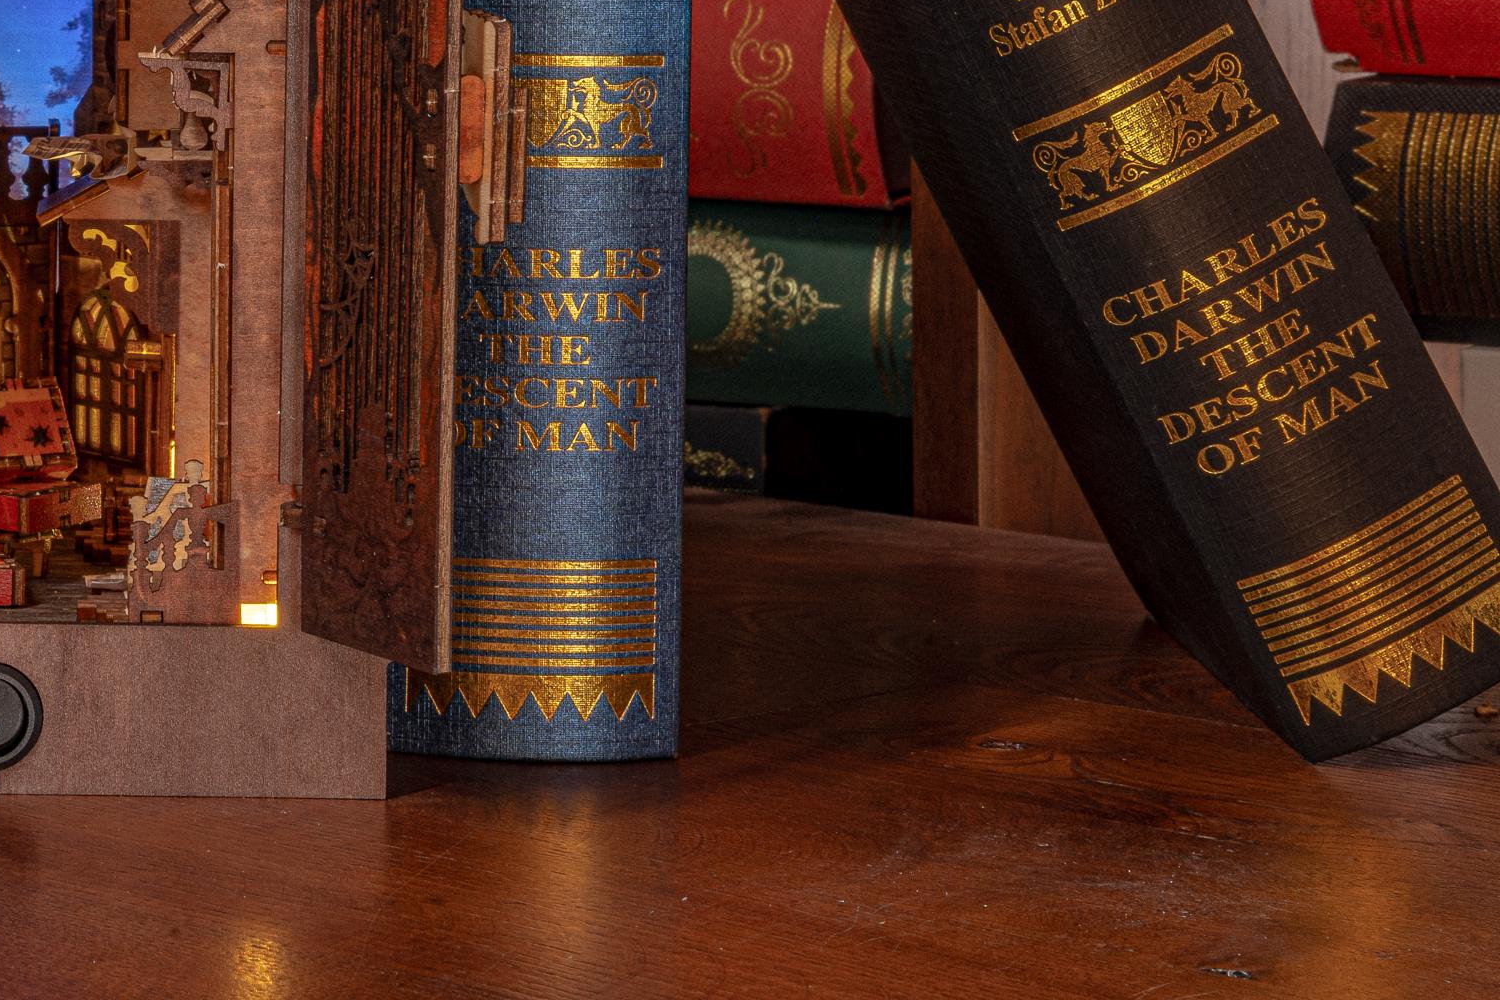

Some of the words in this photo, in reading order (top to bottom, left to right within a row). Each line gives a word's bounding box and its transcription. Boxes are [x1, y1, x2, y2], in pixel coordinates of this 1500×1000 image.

[456, 248, 661, 280] HARLES
[1102, 197, 1328, 327] CHARLES
[460, 290, 650, 322] ARWIN
[1129, 241, 1337, 366] DARWIN
[479, 333, 591, 366] THE
[1199, 308, 1311, 381] THE
[455, 375, 658, 409] ESCENT
[1156, 313, 1381, 446] DESCENT
[514, 420, 640, 452] MAN
[1196, 426, 1264, 476] OF
[1272, 360, 1390, 446] MAN
